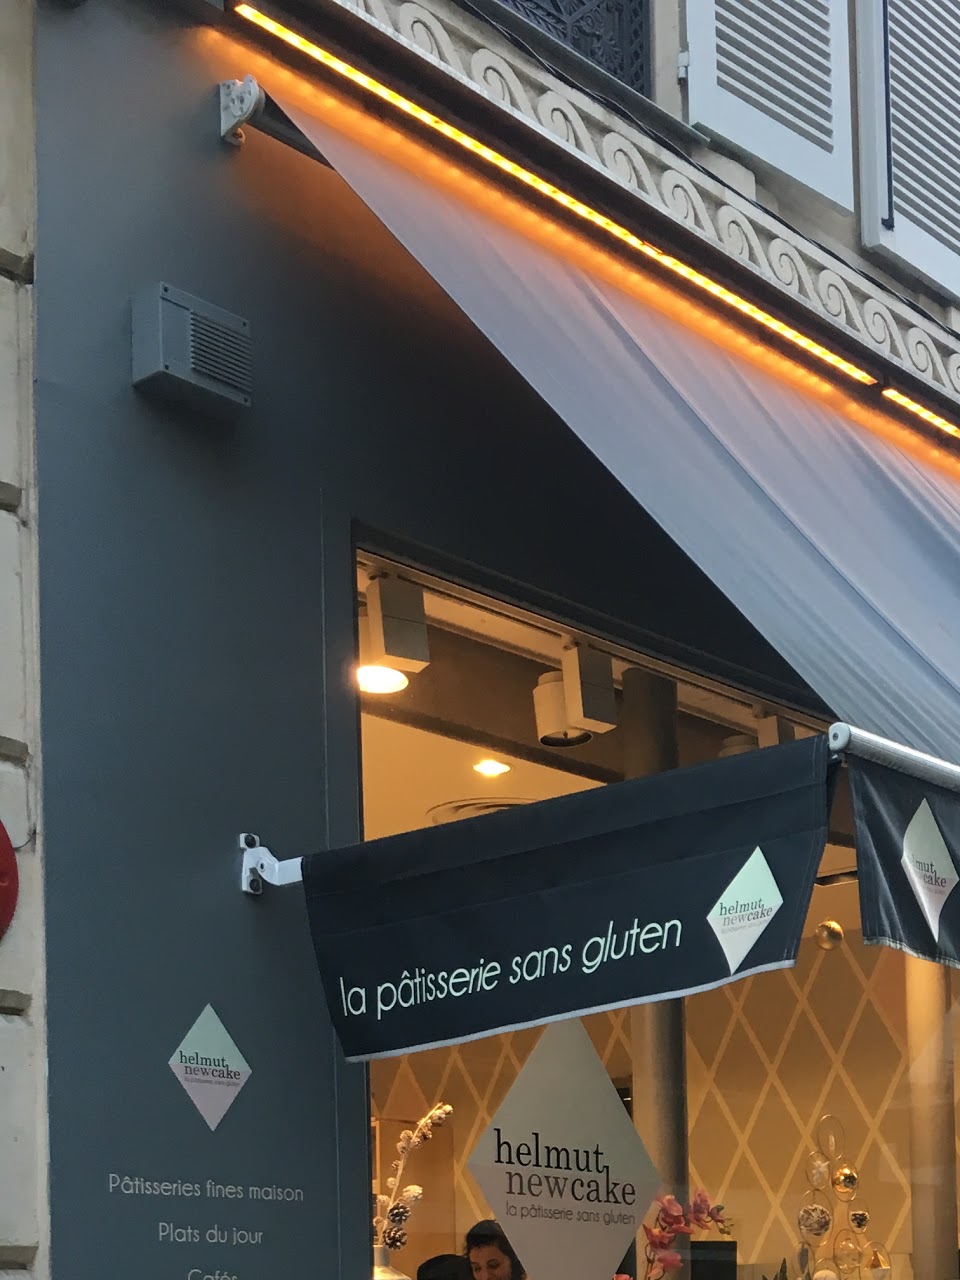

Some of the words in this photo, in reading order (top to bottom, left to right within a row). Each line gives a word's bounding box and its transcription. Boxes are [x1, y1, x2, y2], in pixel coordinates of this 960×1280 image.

[719, 898, 764, 916] helmut
[722, 904, 773, 927] newcake
[340, 976, 366, 1017] la
[377, 957, 501, 1021] pâtisserie
[509, 944, 573, 985] sans
[582, 918, 683, 975] gluten
[179, 1050, 227, 1068] helmut
[184, 1064, 241, 1080] newcake
[494, 1128, 605, 1174] helmut
[109, 1173, 201, 1196] Pâtisseries
[206, 1179, 244, 1199] fines
[249, 1185, 304, 1201] maison
[505, 1165, 636, 1206] newcake
[505, 1201, 517, 1216] la
[520, 1203, 573, 1220] pâtisserie
[577, 1209, 600, 1223] sans
[603, 1212, 635, 1226] gluten
[158, 1222, 200, 1242] Plats
[206, 1225, 228, 1243] du
[232, 1227, 263, 1245] jour
